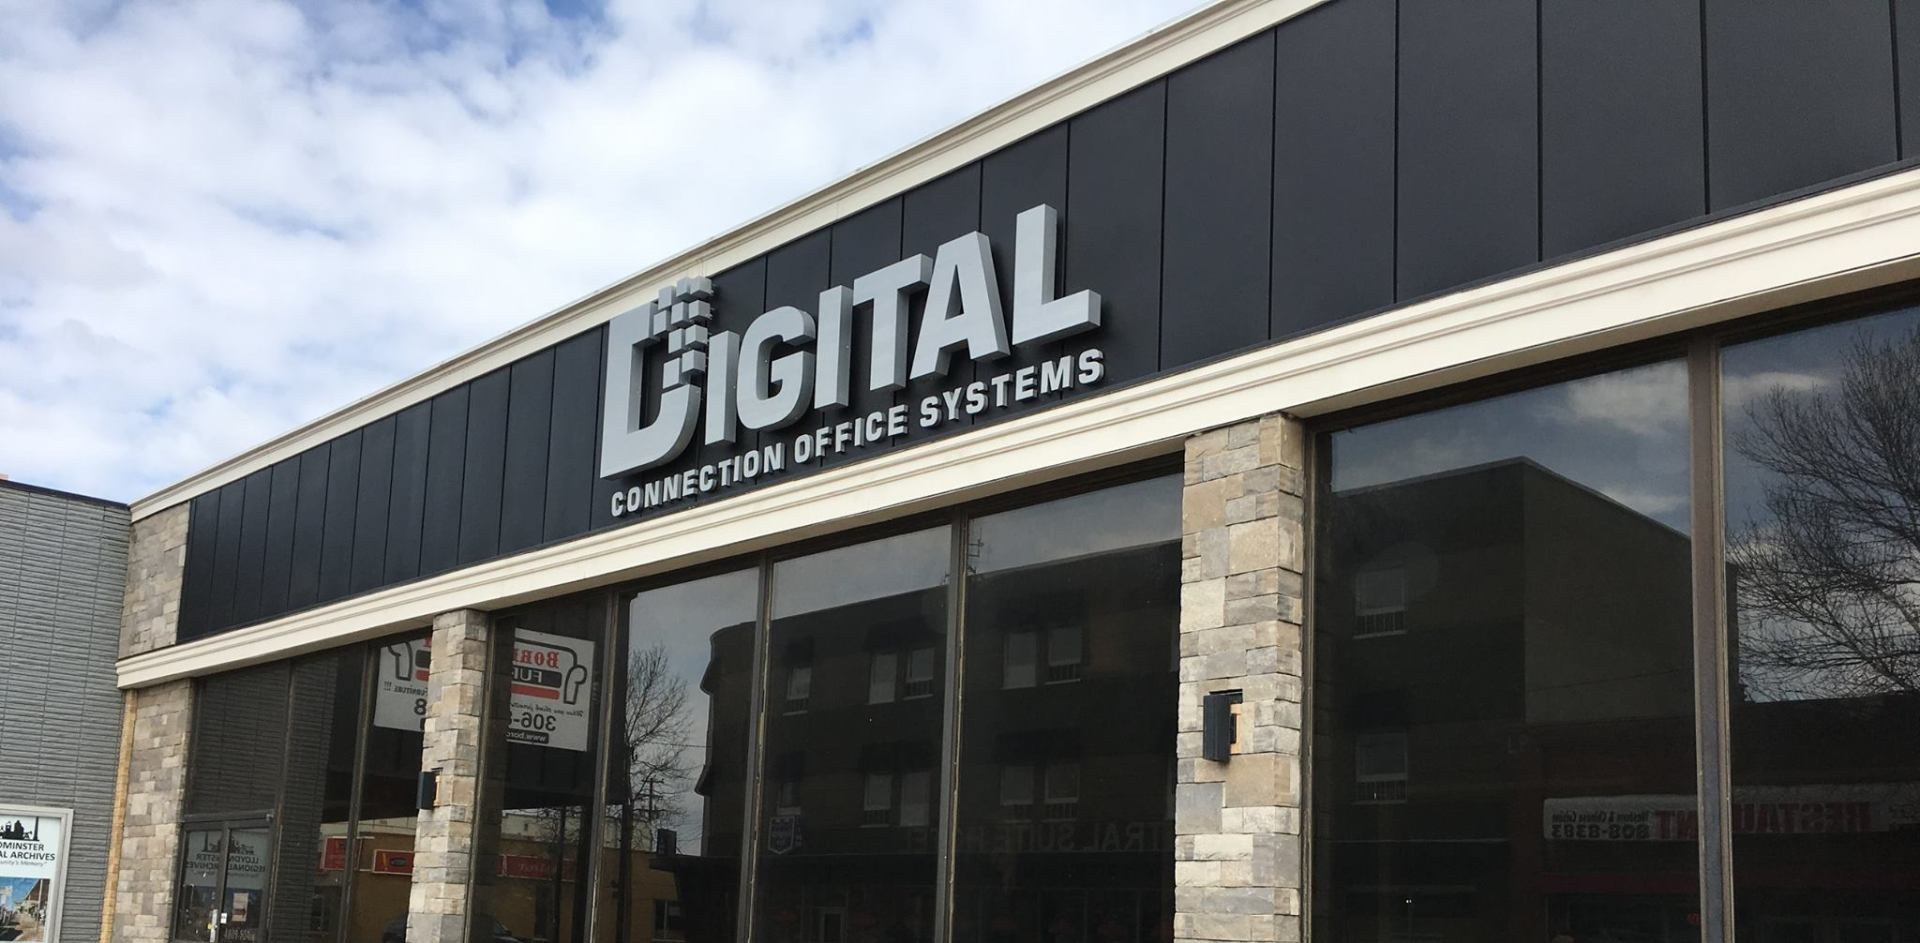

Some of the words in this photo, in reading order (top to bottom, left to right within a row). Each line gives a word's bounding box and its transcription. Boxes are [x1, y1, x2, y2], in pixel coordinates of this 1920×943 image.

[600, 204, 1101, 479] DIGITAL
[610, 442, 785, 517] CONNECTION
[794, 404, 909, 464] OFFICE
[919, 348, 1105, 428] SYSTEMS
[10, 851, 56, 861] ARCHIVES
